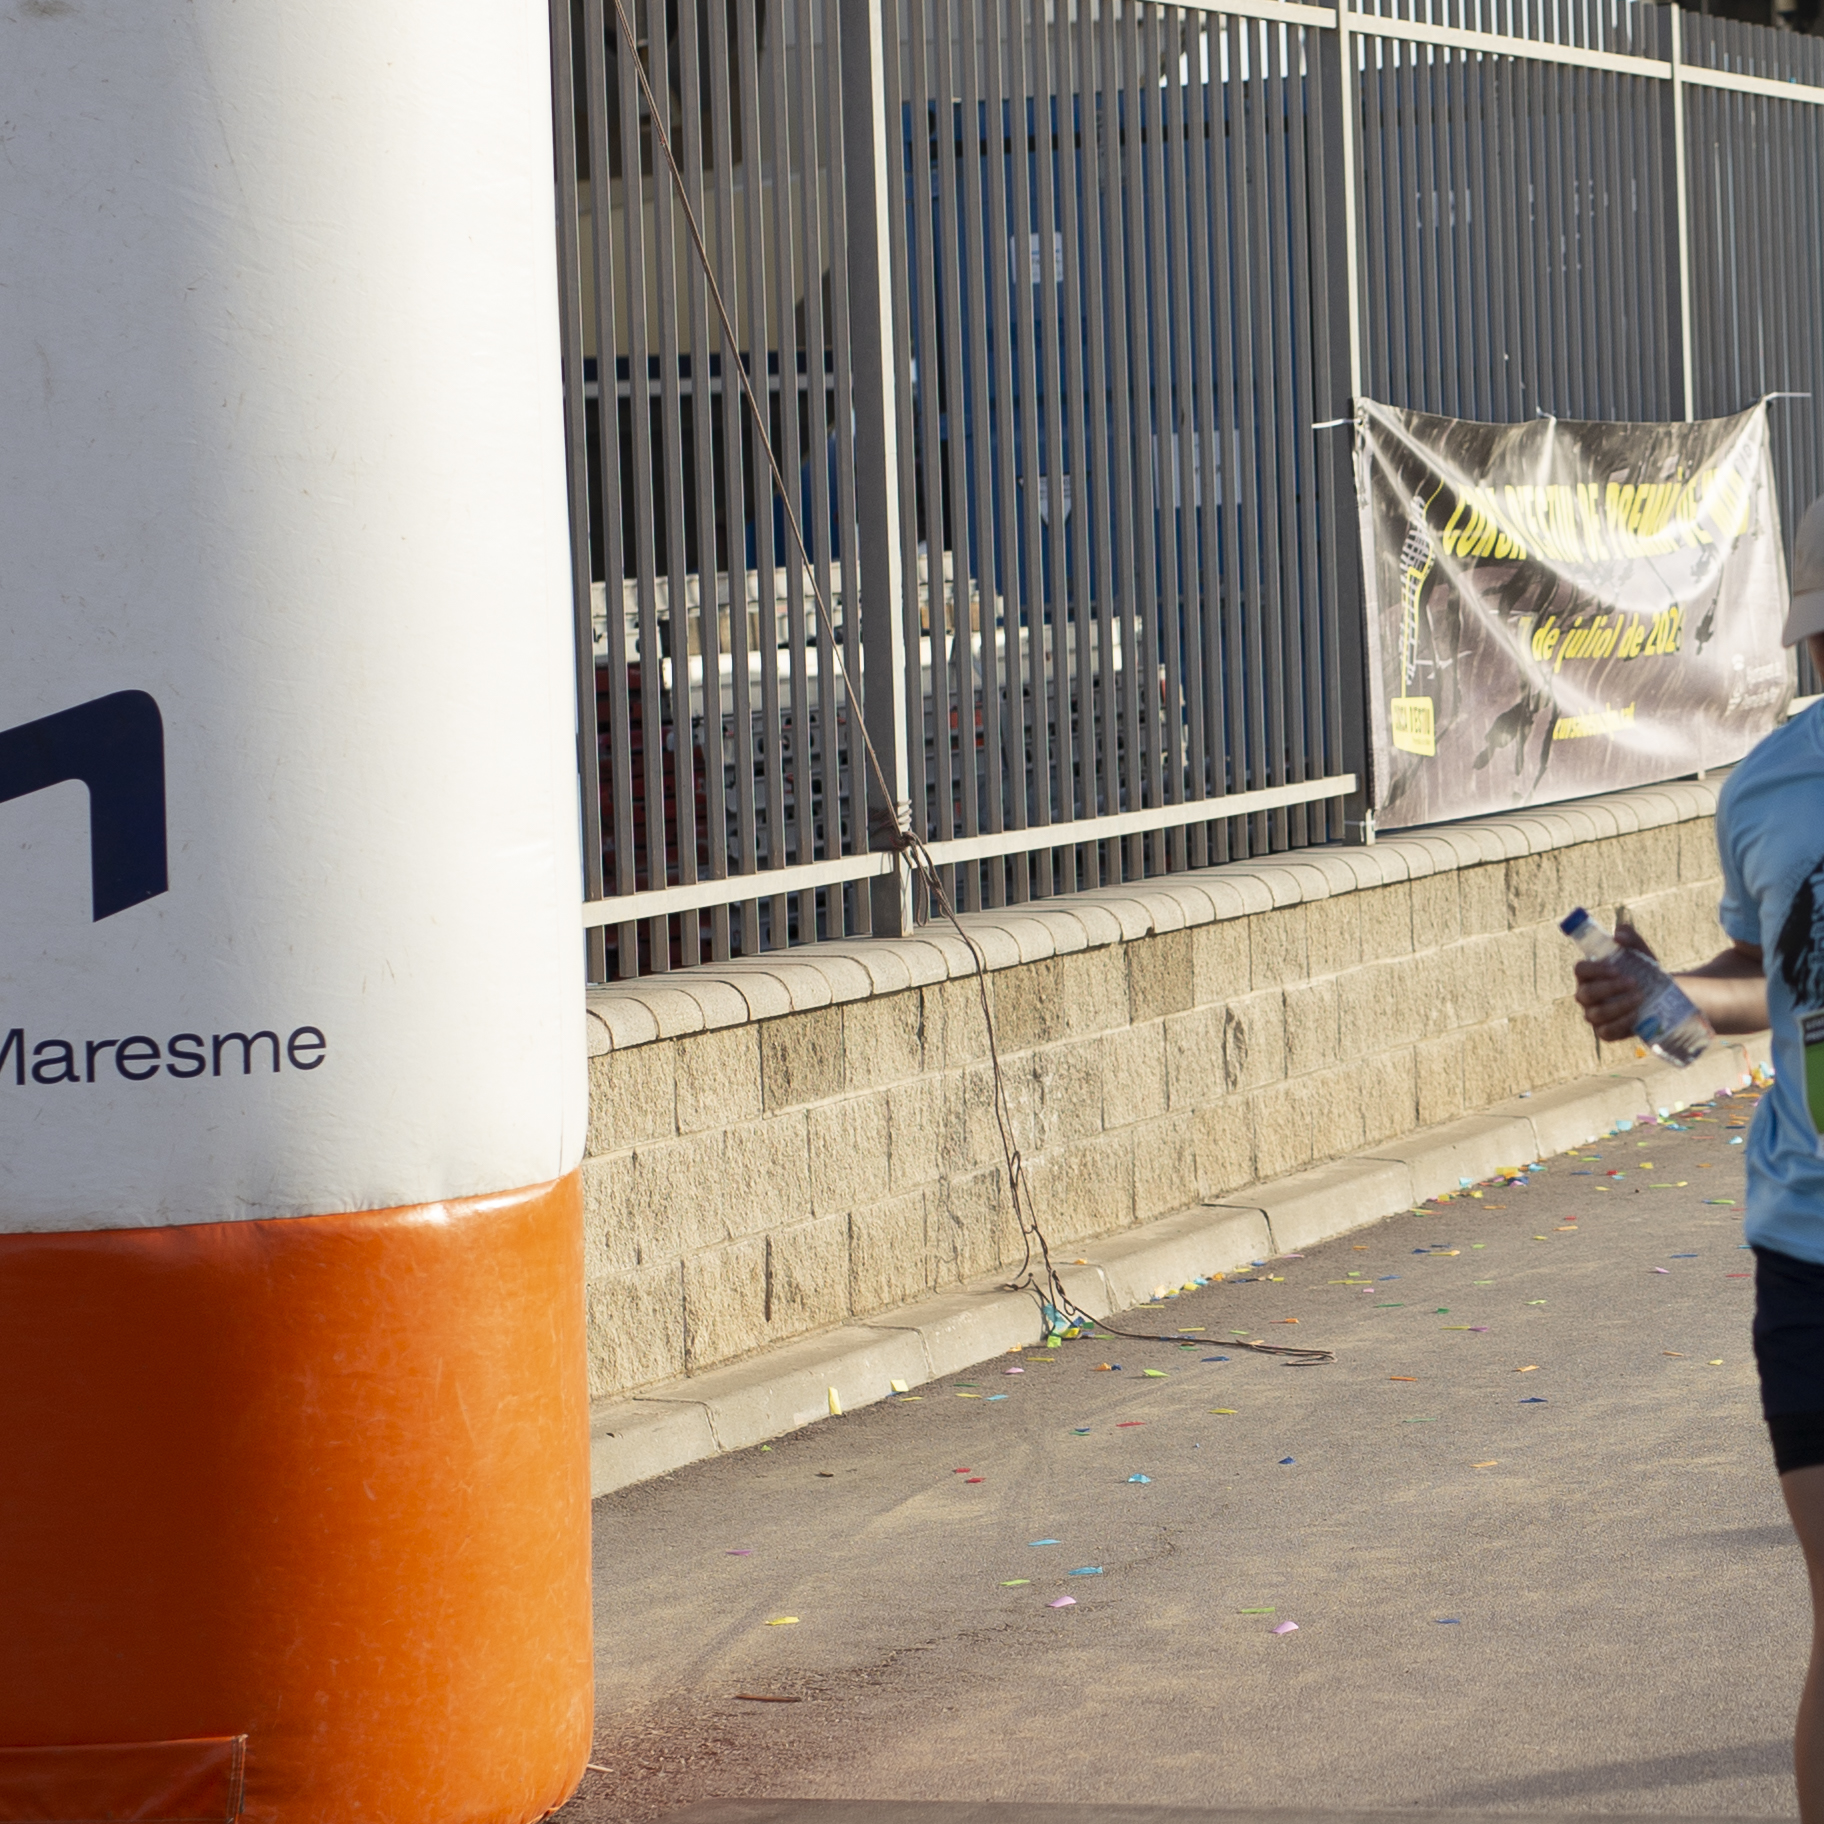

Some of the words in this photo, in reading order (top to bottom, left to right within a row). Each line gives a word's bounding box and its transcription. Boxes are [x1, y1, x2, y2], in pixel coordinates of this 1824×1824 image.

[1532, 615, 1561, 662] de
[1554, 614, 1625, 674] juliol
[1617, 612, 1645, 658] de
[1643, 606, 1685, 657] 202
